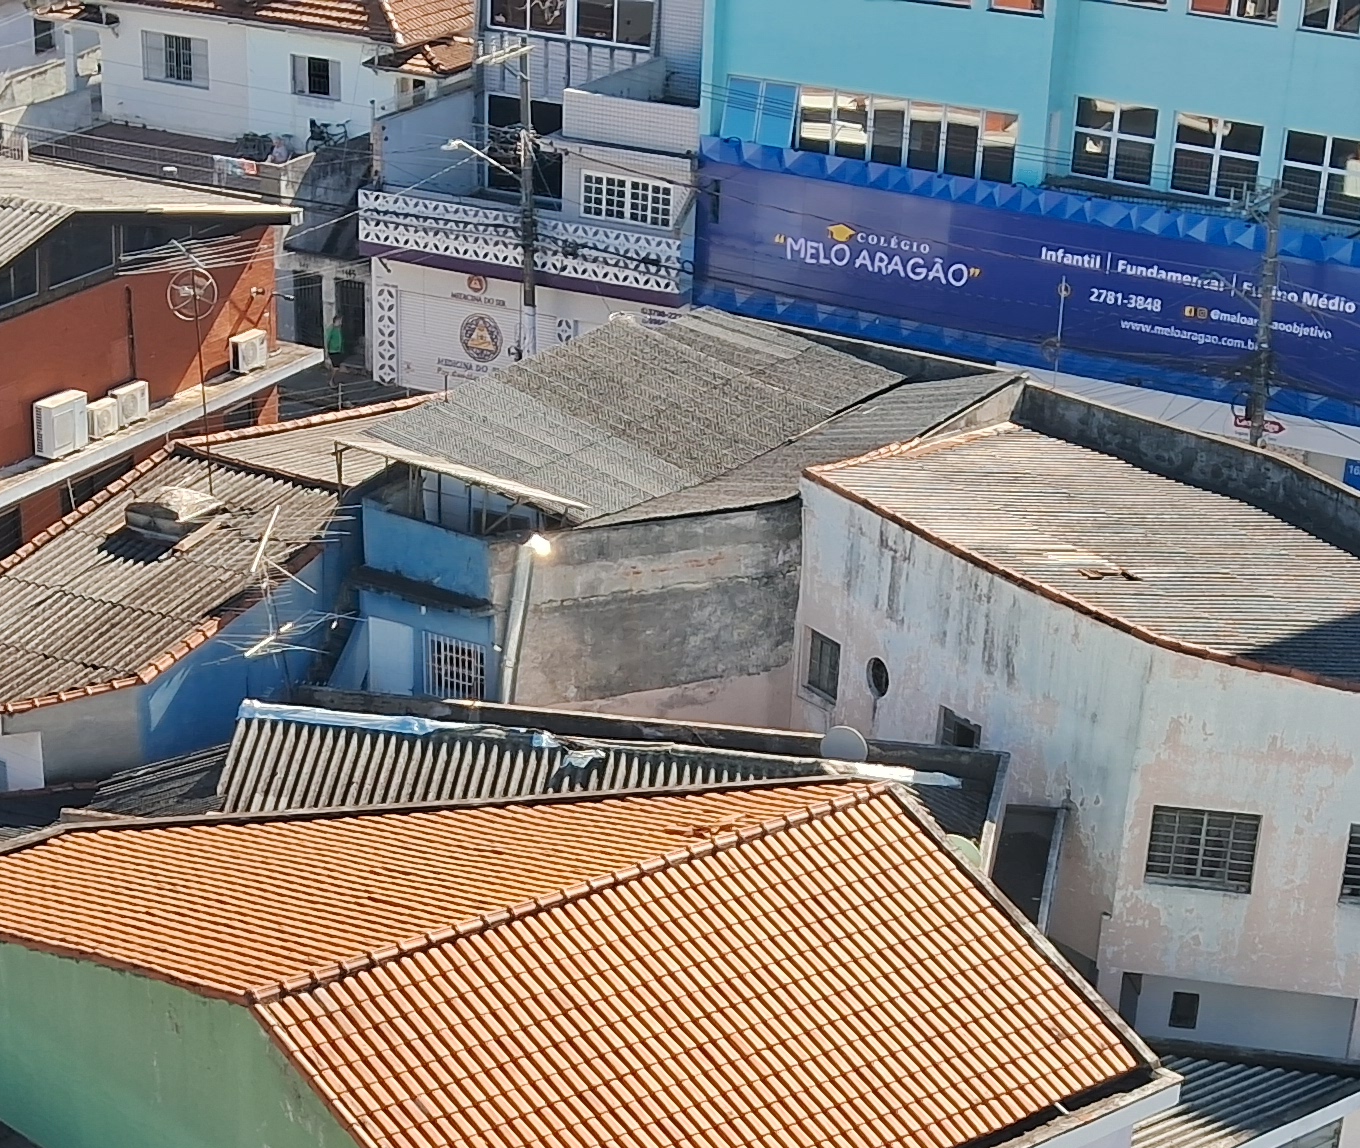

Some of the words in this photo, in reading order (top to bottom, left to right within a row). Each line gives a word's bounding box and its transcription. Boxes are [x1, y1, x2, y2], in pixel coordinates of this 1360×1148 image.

[856, 231, 931, 254] COLÉGIO
[1040, 246, 1101, 269] Infantil
[1302, 290, 1357, 313] Médio
[1089, 288, 1162, 312] 2781-3848
[1210, 309, 1332, 340] @meloaraoobjetivo
